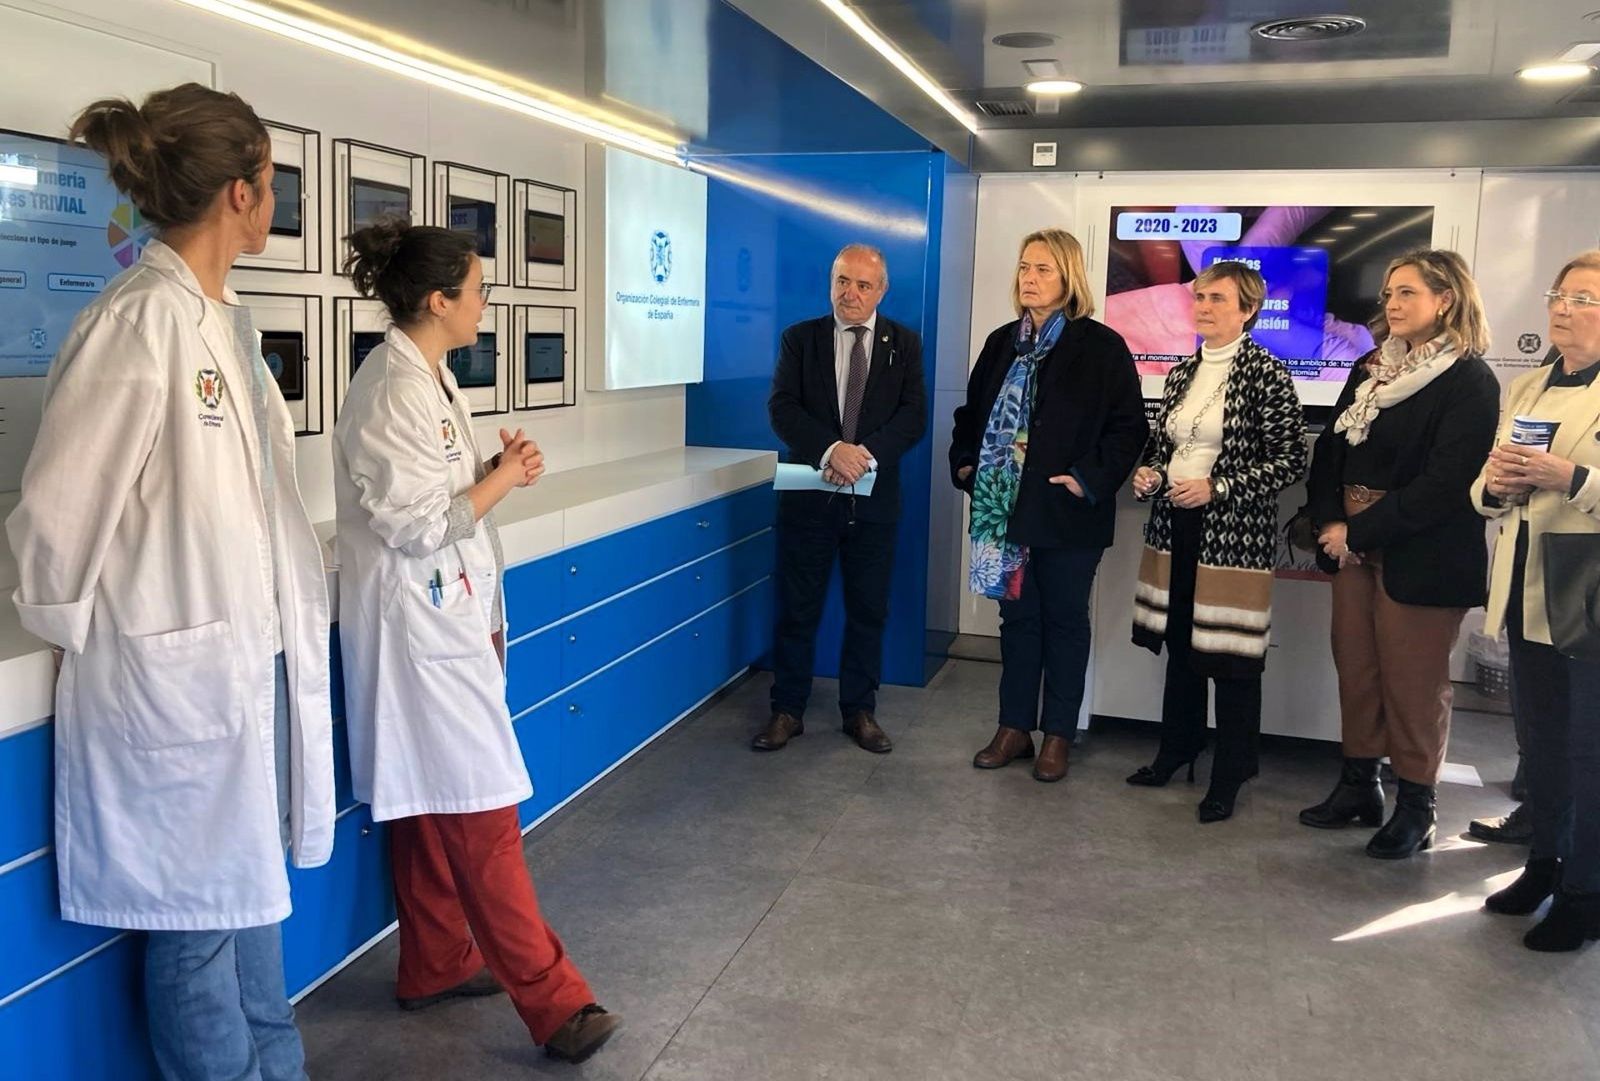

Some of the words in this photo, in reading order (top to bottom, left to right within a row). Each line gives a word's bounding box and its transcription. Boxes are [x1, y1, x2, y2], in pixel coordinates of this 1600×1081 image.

[30, 191, 87, 215] TRIVIAL
[1135, 218, 1171, 233] 2020
[1181, 218, 1218, 233] 2023
[38, 236, 50, 246] tipo
[52, 237, 58, 245] de
[60, 238, 77, 248] juego
[650, 294, 669, 306] Colegial
[671, 295, 677, 305] de
[1261, 299, 1290, 311] uras
[647, 310, 653, 319] de
[655, 309, 674, 320] España
[1254, 315, 1290, 331] nsión
[1147, 355, 1179, 363] momento,
[1288, 358, 1299, 366] los
[1300, 359, 1327, 367] ámbitos
